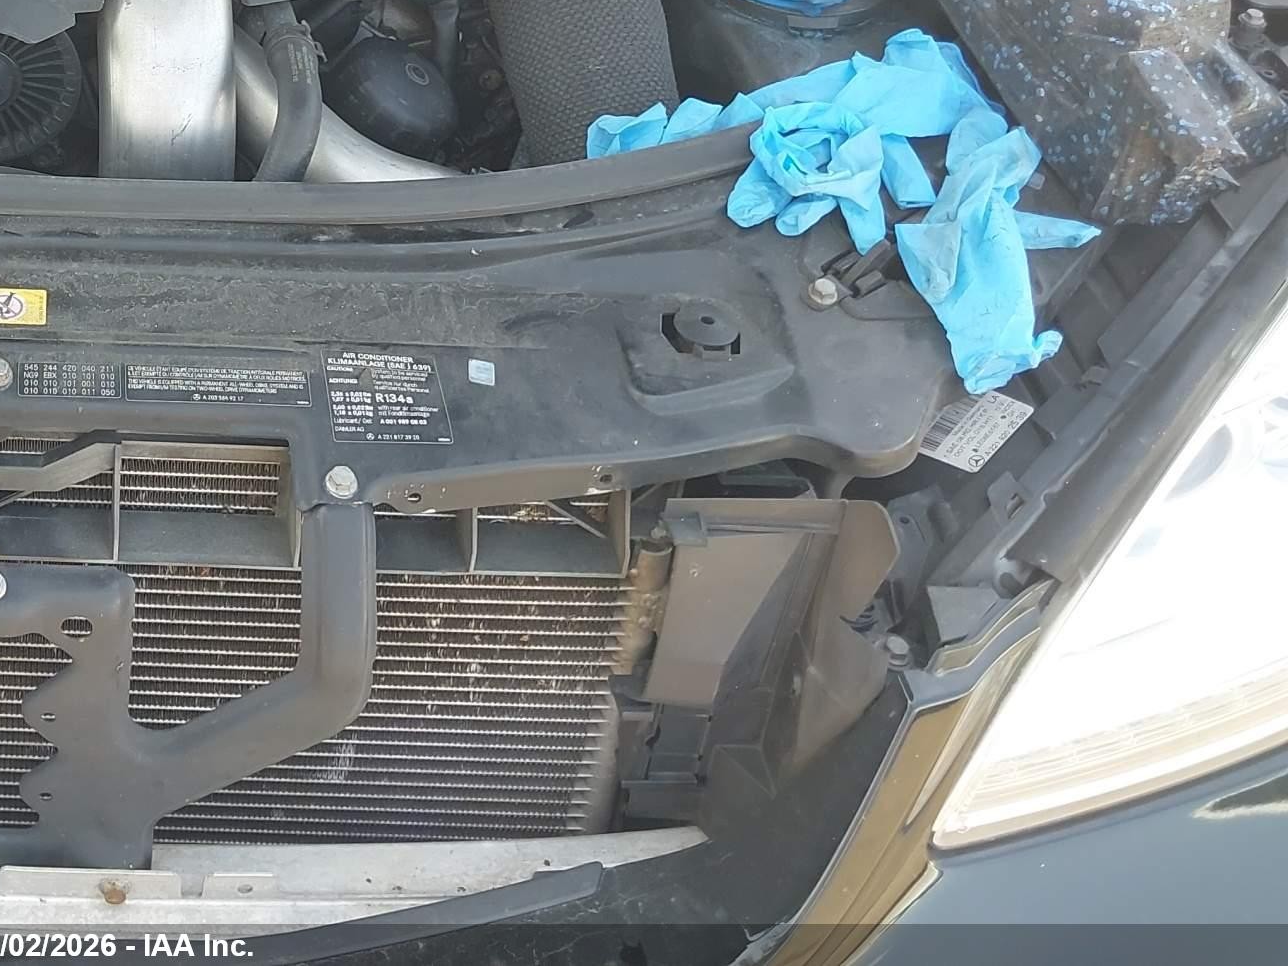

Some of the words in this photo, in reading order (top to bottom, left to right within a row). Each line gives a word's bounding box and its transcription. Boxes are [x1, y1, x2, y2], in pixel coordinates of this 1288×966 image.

[357, 353, 414, 363] CONDITIONER
[327, 357, 386, 368] KLIMAANLAGE
[387, 362, 405, 370] (SAE
[412, 364, 432, 372] 639)
[375, 392, 414, 404] R134a
